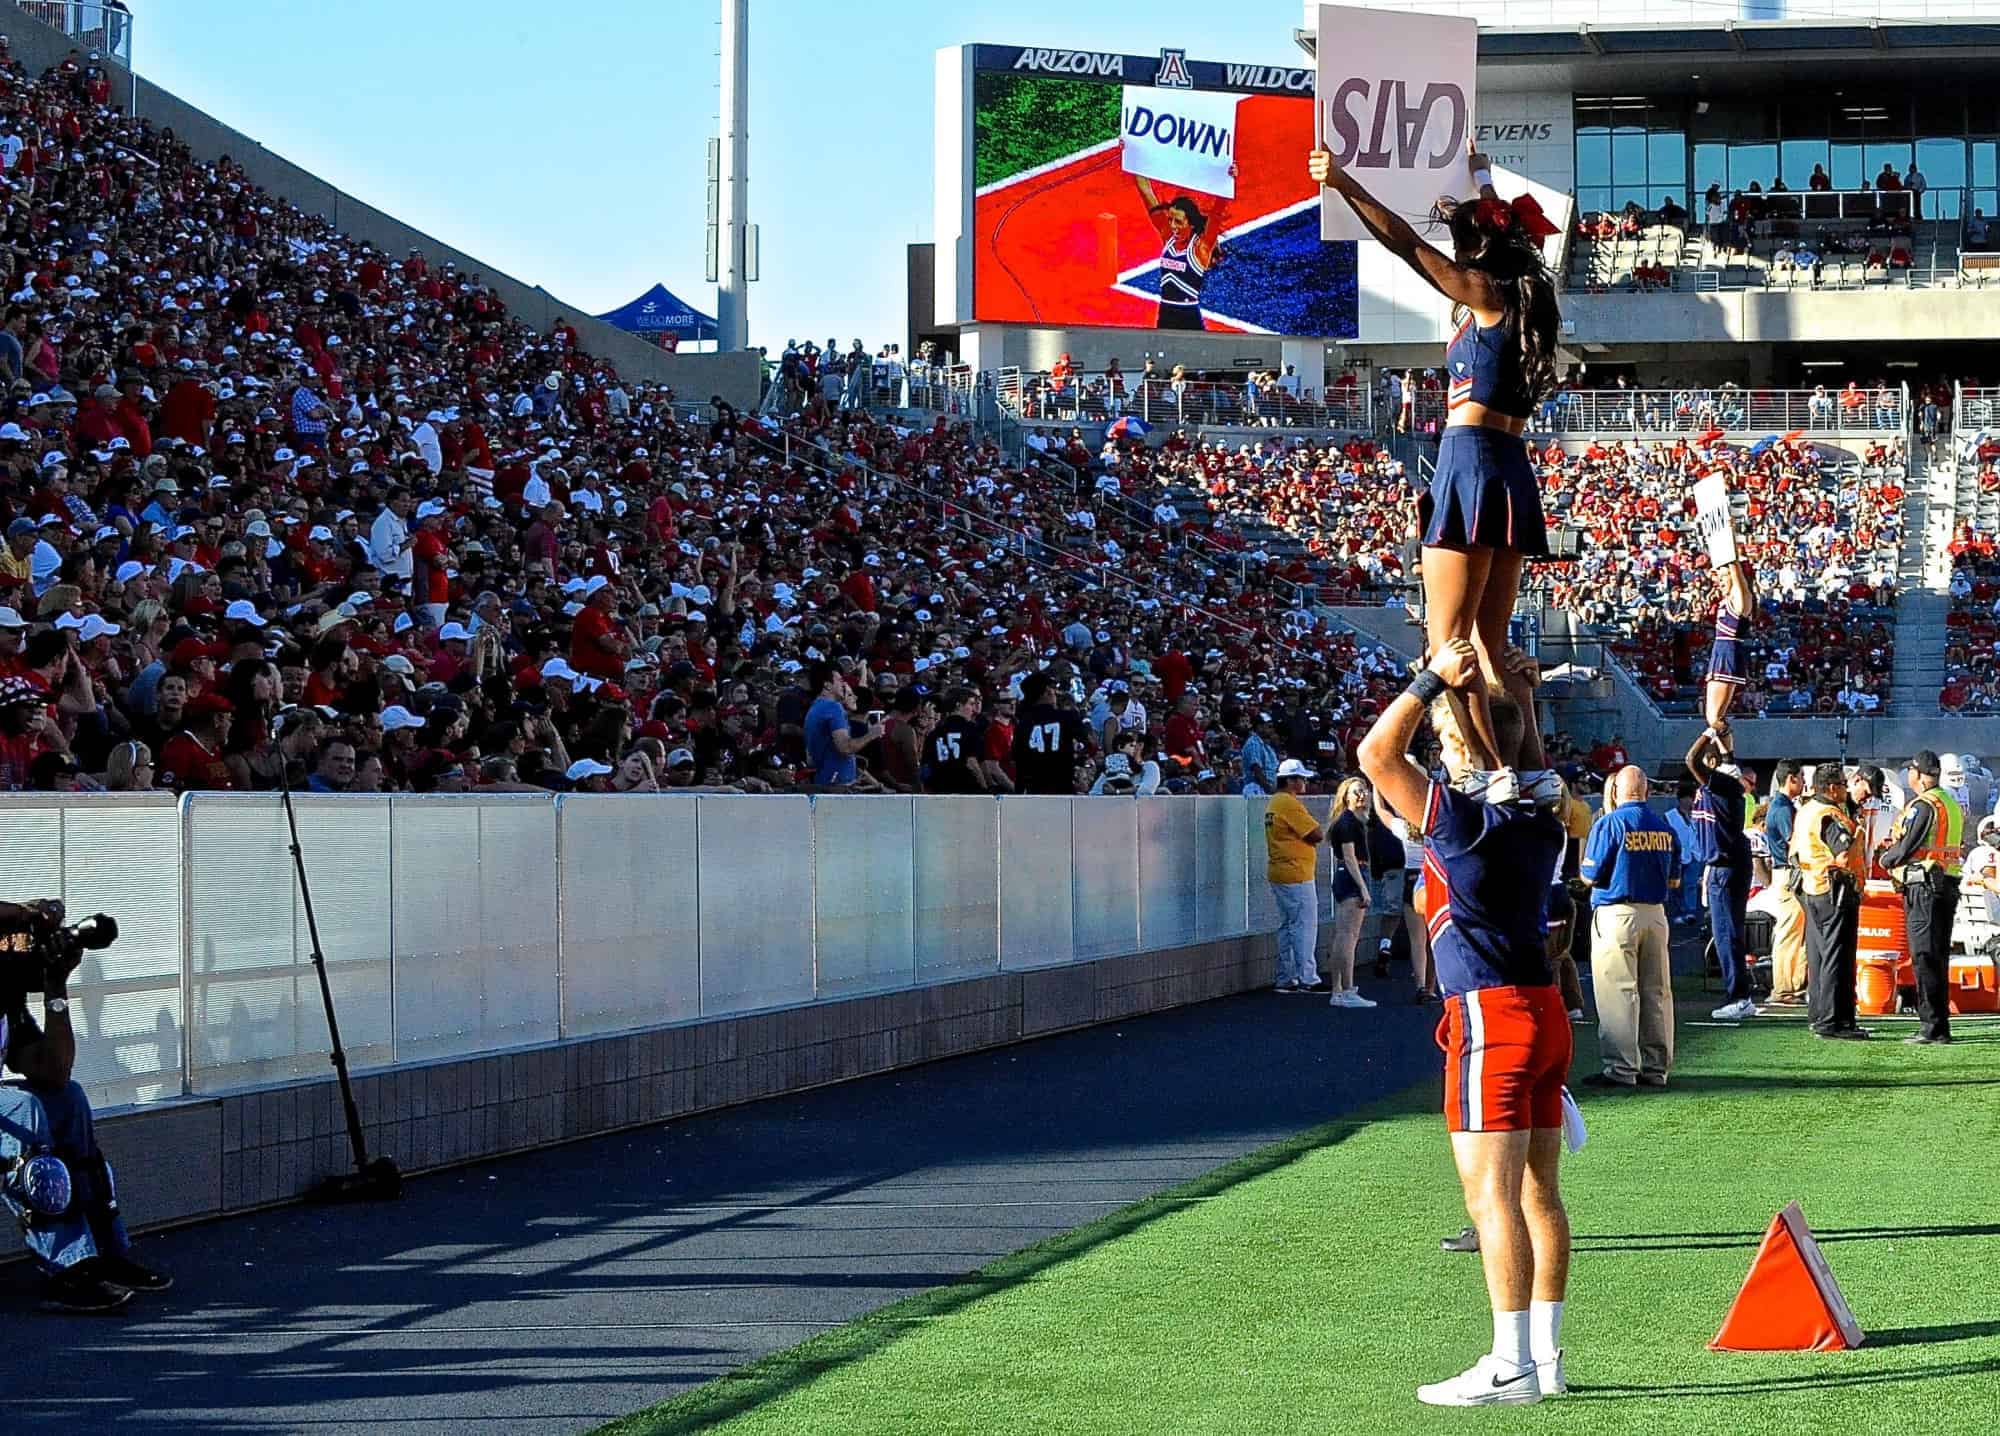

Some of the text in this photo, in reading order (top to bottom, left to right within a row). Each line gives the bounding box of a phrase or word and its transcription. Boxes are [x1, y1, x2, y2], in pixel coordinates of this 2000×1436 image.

[1014, 48, 1124, 76] ARIZONA
[1156, 47, 1192, 89] A
[1128, 106, 1227, 157] DOWN
[1332, 77, 1466, 168] CATS
[1475, 123, 1552, 141] EVENS
[1029, 722, 1060, 753] 47
[1625, 831, 1673, 851] SECURITY
